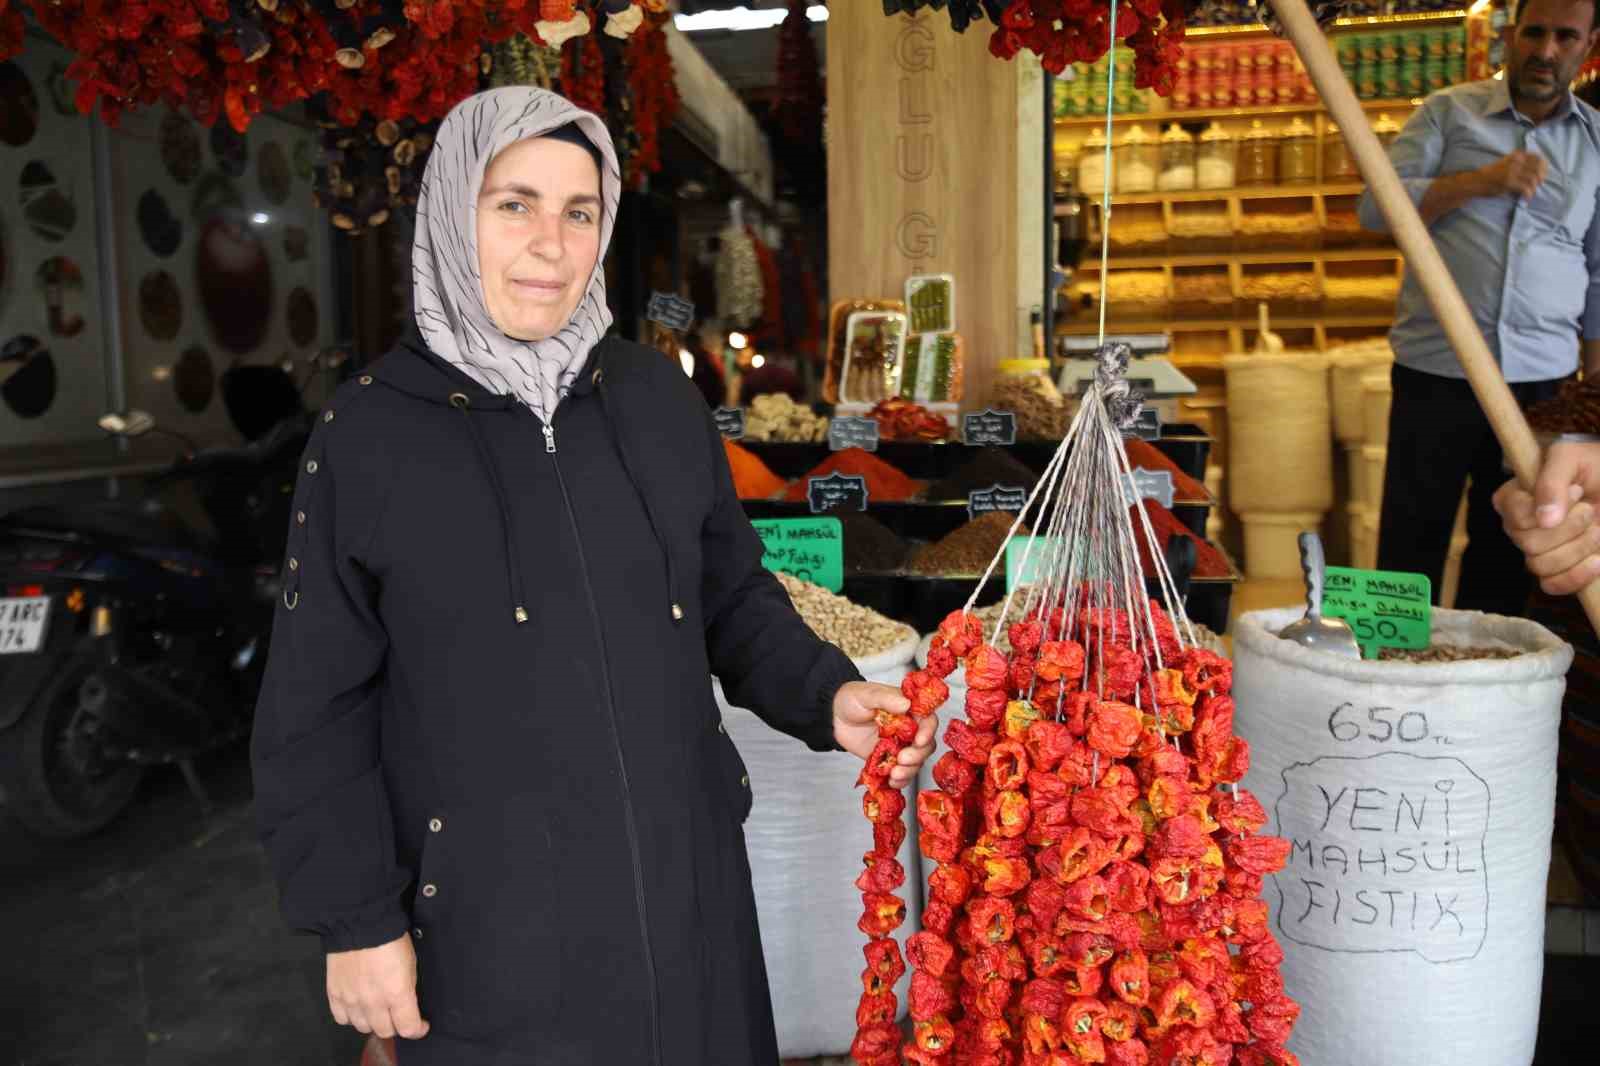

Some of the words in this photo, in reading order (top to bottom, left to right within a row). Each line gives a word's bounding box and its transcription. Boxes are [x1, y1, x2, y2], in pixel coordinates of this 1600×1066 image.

[896, 212, 937, 274] G
[1350, 618, 1398, 640] 50
[1328, 701, 1429, 743] 650
[1291, 838, 1477, 877] MAHSÜL
[1297, 877, 1464, 936] FISTIK
